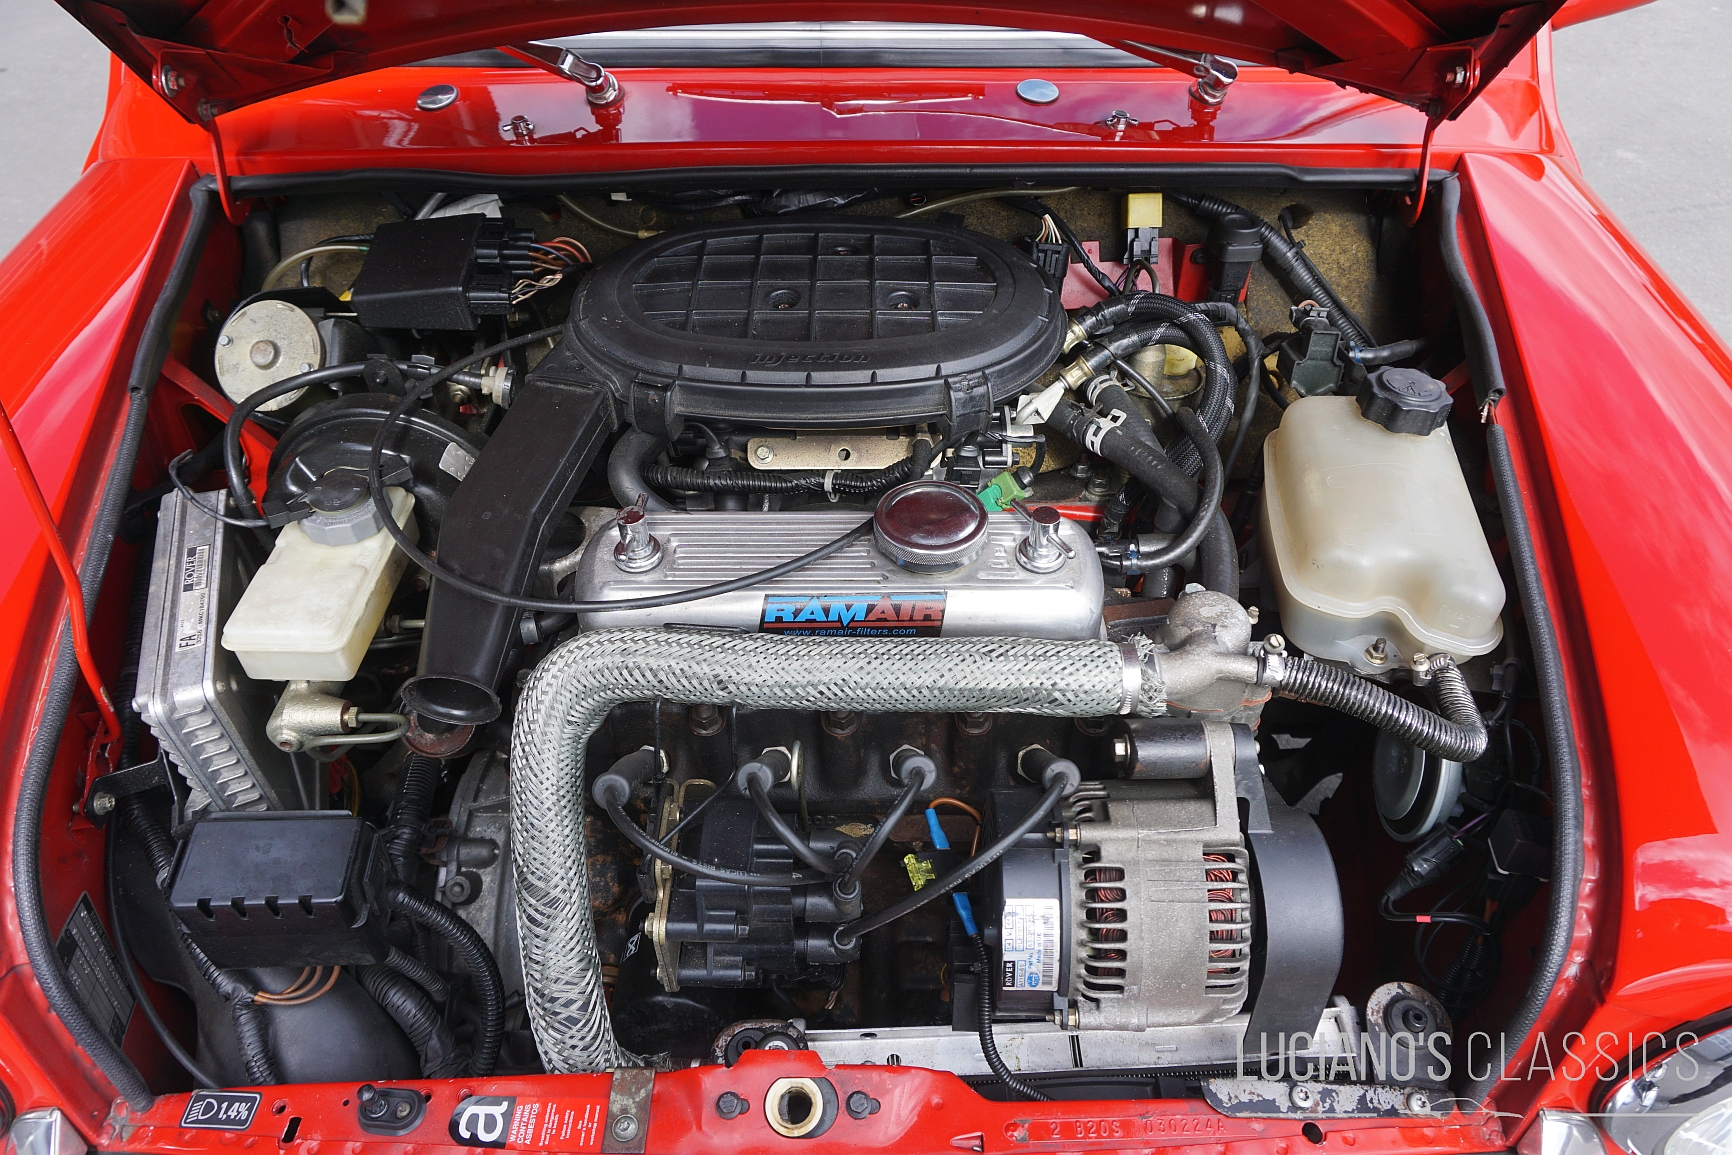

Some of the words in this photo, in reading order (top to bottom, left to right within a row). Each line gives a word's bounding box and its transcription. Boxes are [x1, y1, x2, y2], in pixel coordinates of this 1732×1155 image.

[750, 352, 871, 367] injection
[184, 556, 196, 585] ROVER
[764, 595, 944, 627] RAMAIR
[179, 634, 197, 649] FA
[783, 627, 917, 636] www.ramair-filters.com
[720, 867, 748, 877] LUCAS
[218, 1101, 251, 1120] 1,4%
[458, 1101, 509, 1142] a
[509, 1105, 524, 1142] WARNING
[517, 1104, 532, 1144] CONTAINS
[525, 1103, 539, 1145] ASBESTOS
[1050, 1120, 1061, 1138] 2
